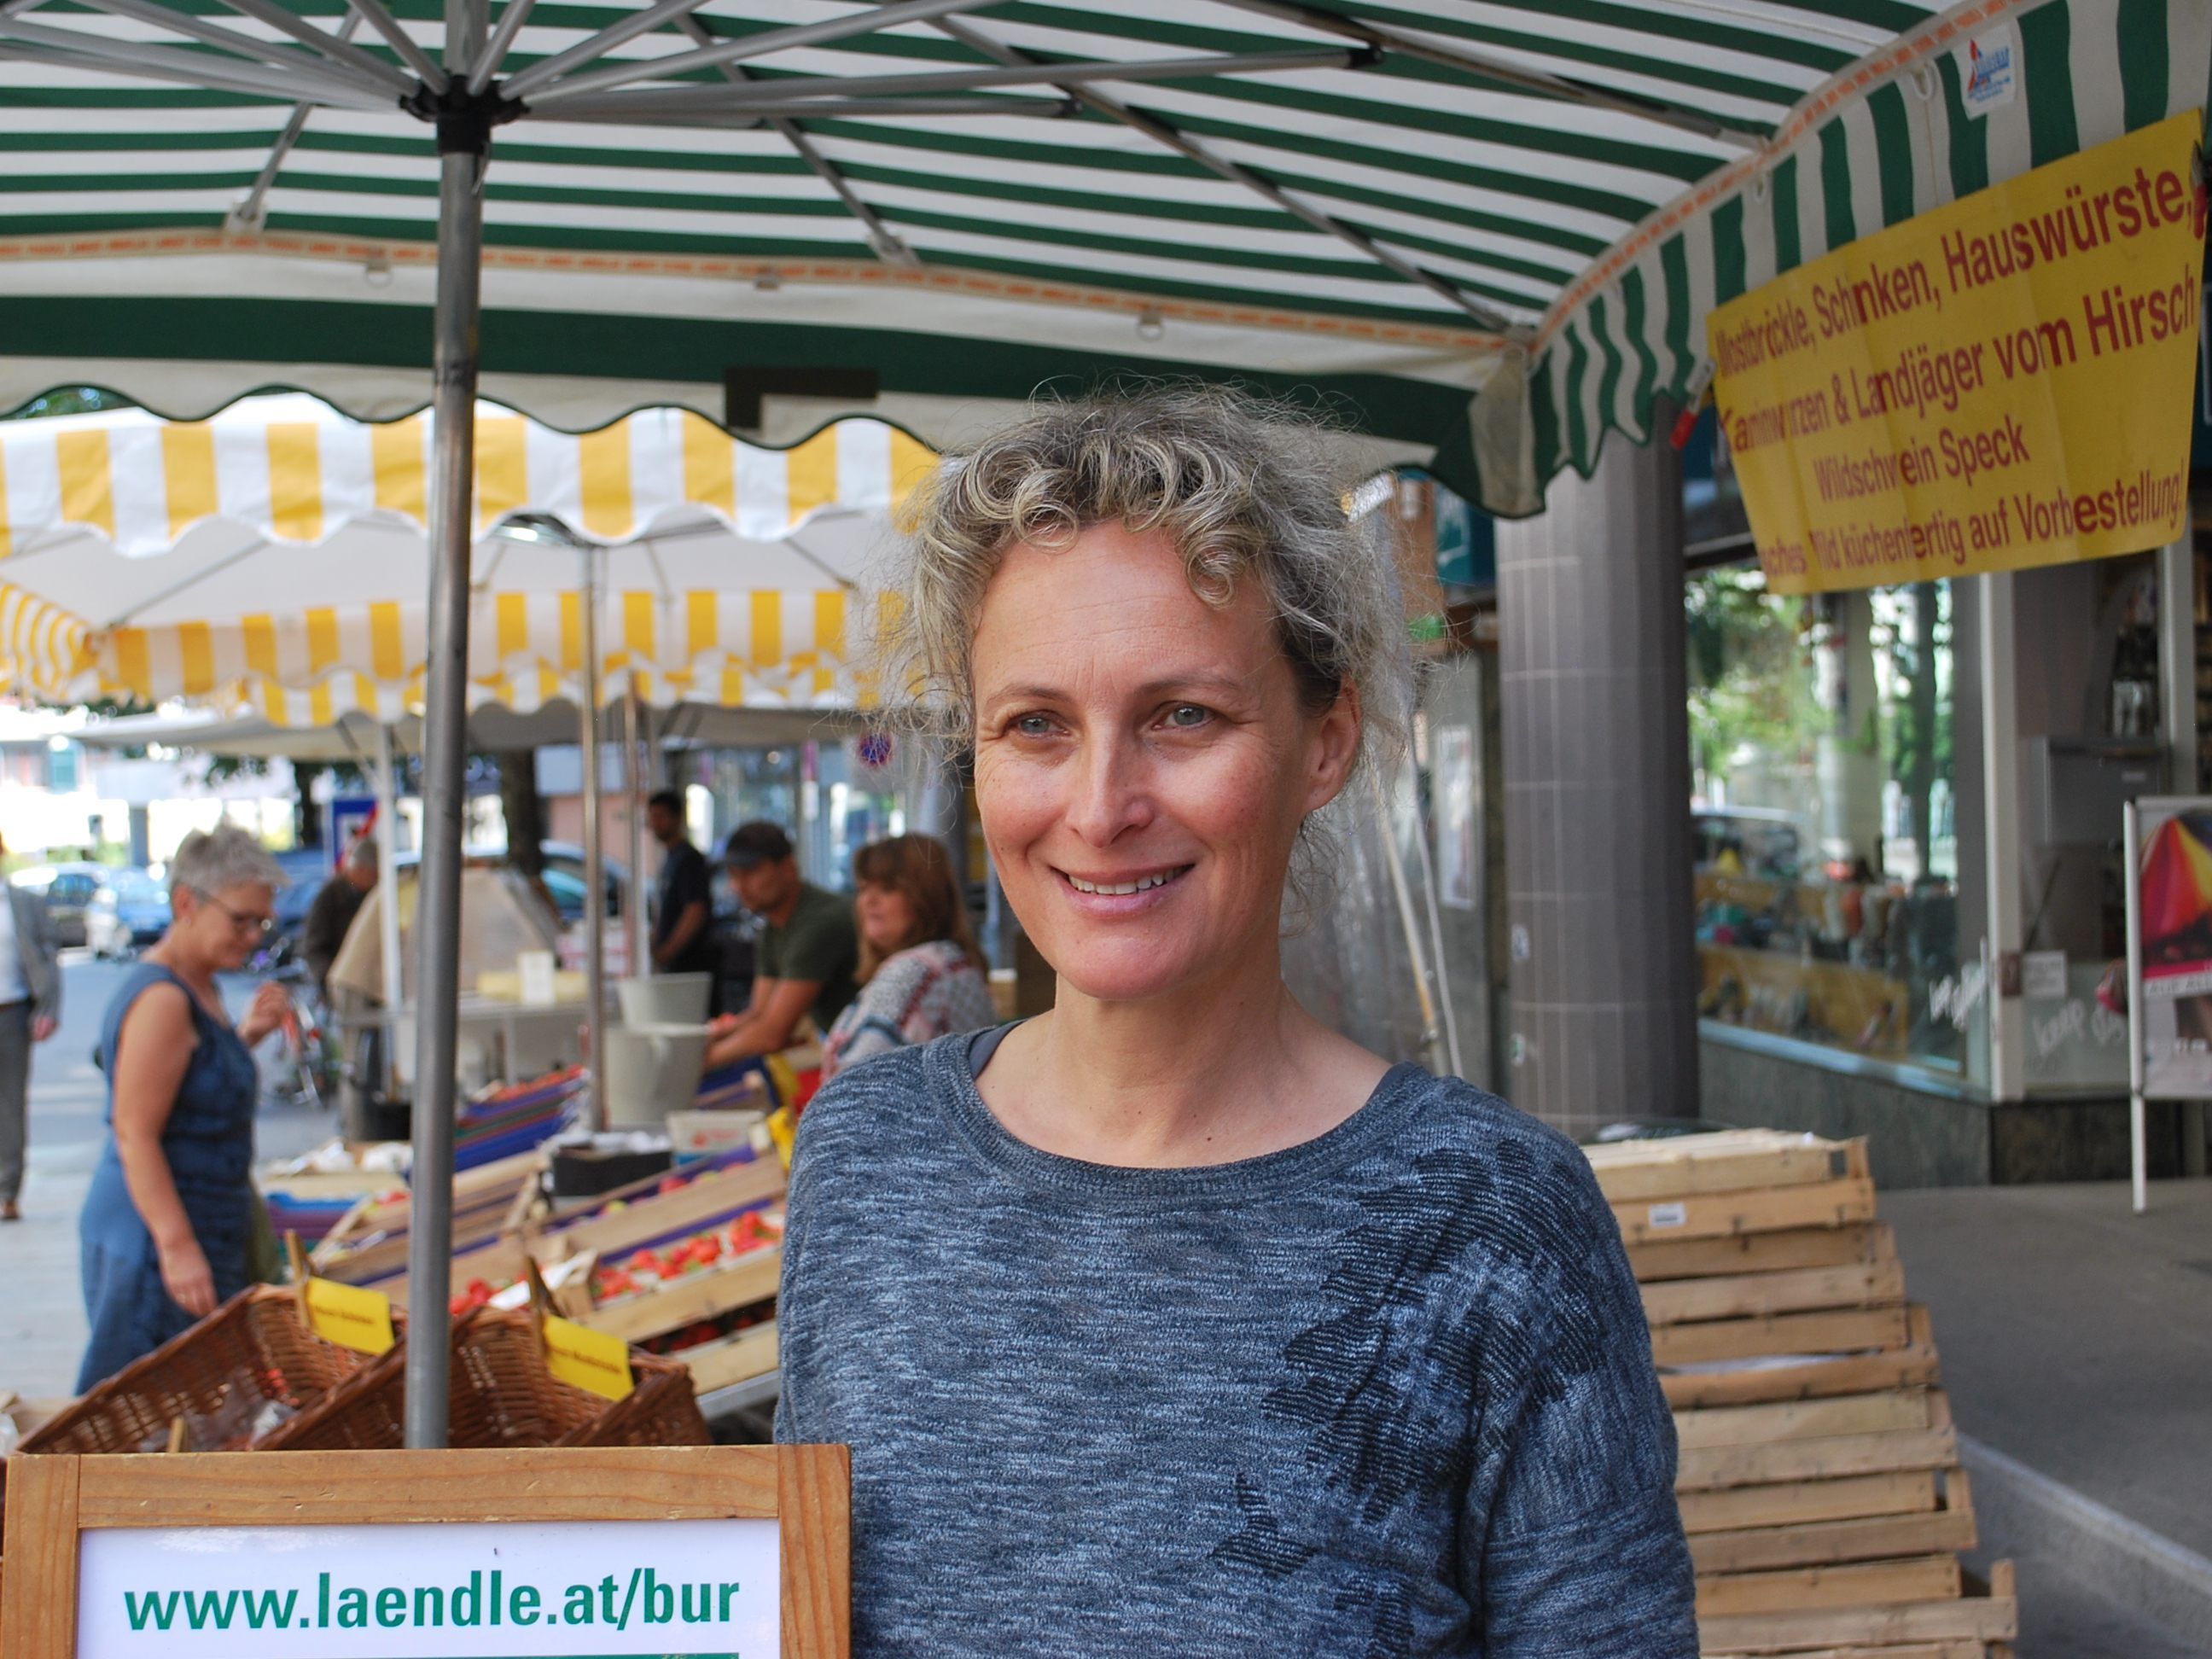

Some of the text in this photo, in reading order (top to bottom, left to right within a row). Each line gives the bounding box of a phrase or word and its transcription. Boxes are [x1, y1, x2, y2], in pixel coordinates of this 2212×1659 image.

[1940, 166, 2193, 294] Hauswürste,
[1831, 372, 1852, 425] &
[1849, 342, 1984, 420] Landjäger
[1992, 316, 2078, 380] vom
[2081, 261, 2196, 357] Hirsch
[1939, 413, 2031, 487] Speck
[1968, 497, 2011, 553] auf
[124, 1568, 741, 1631] www.laendle.at/bur
